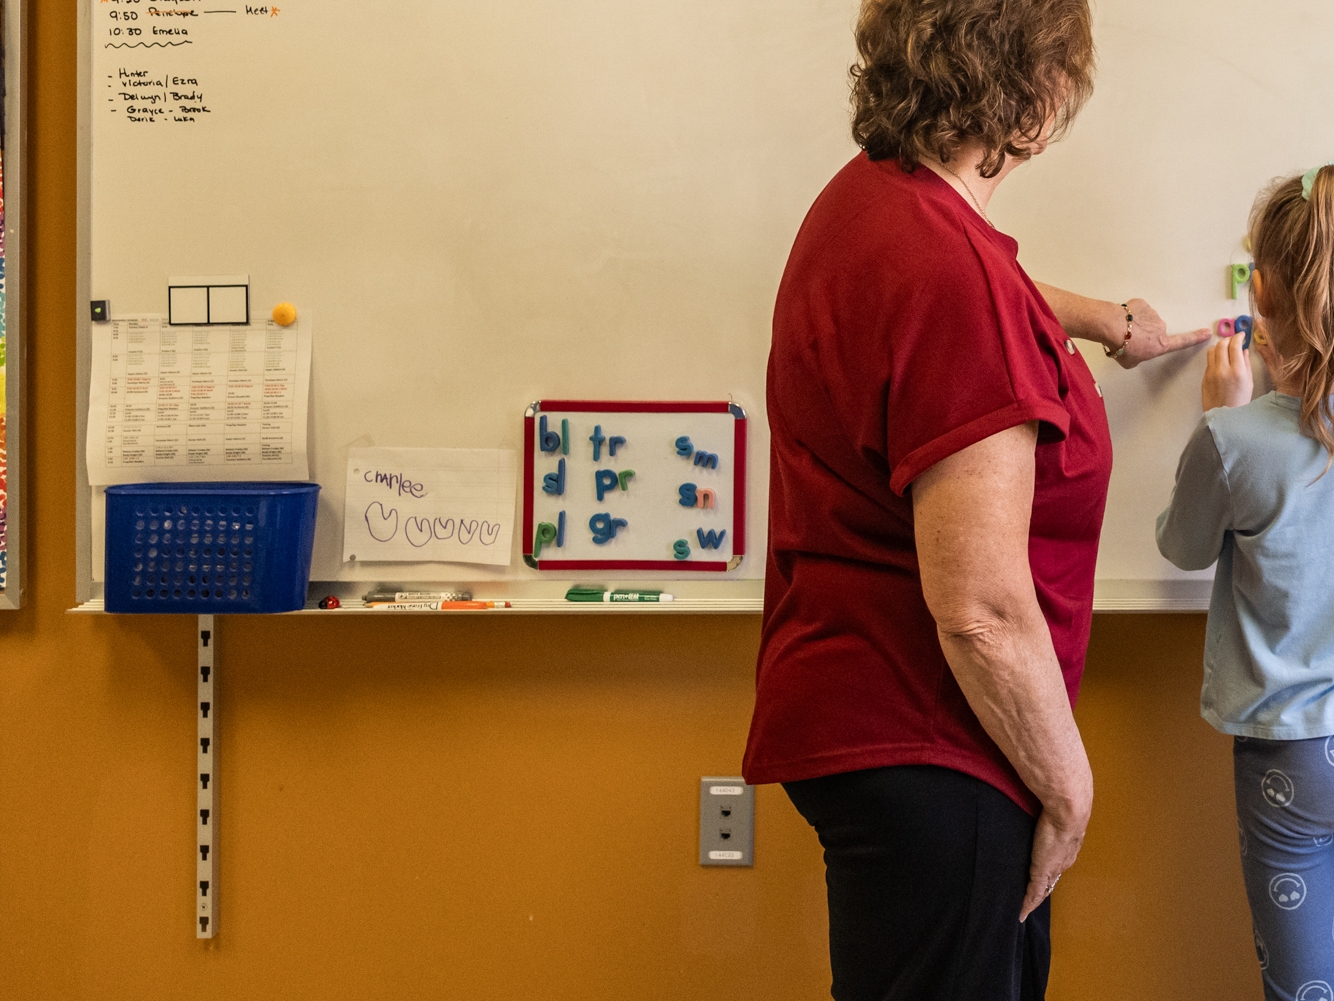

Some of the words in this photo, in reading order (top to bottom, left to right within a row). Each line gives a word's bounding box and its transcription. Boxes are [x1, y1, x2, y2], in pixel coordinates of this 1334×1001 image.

[110, 10, 138, 21] 9:50
[589, 424, 627, 461] tr
[595, 468, 635, 501] pr
[679, 482, 715, 509] sn
